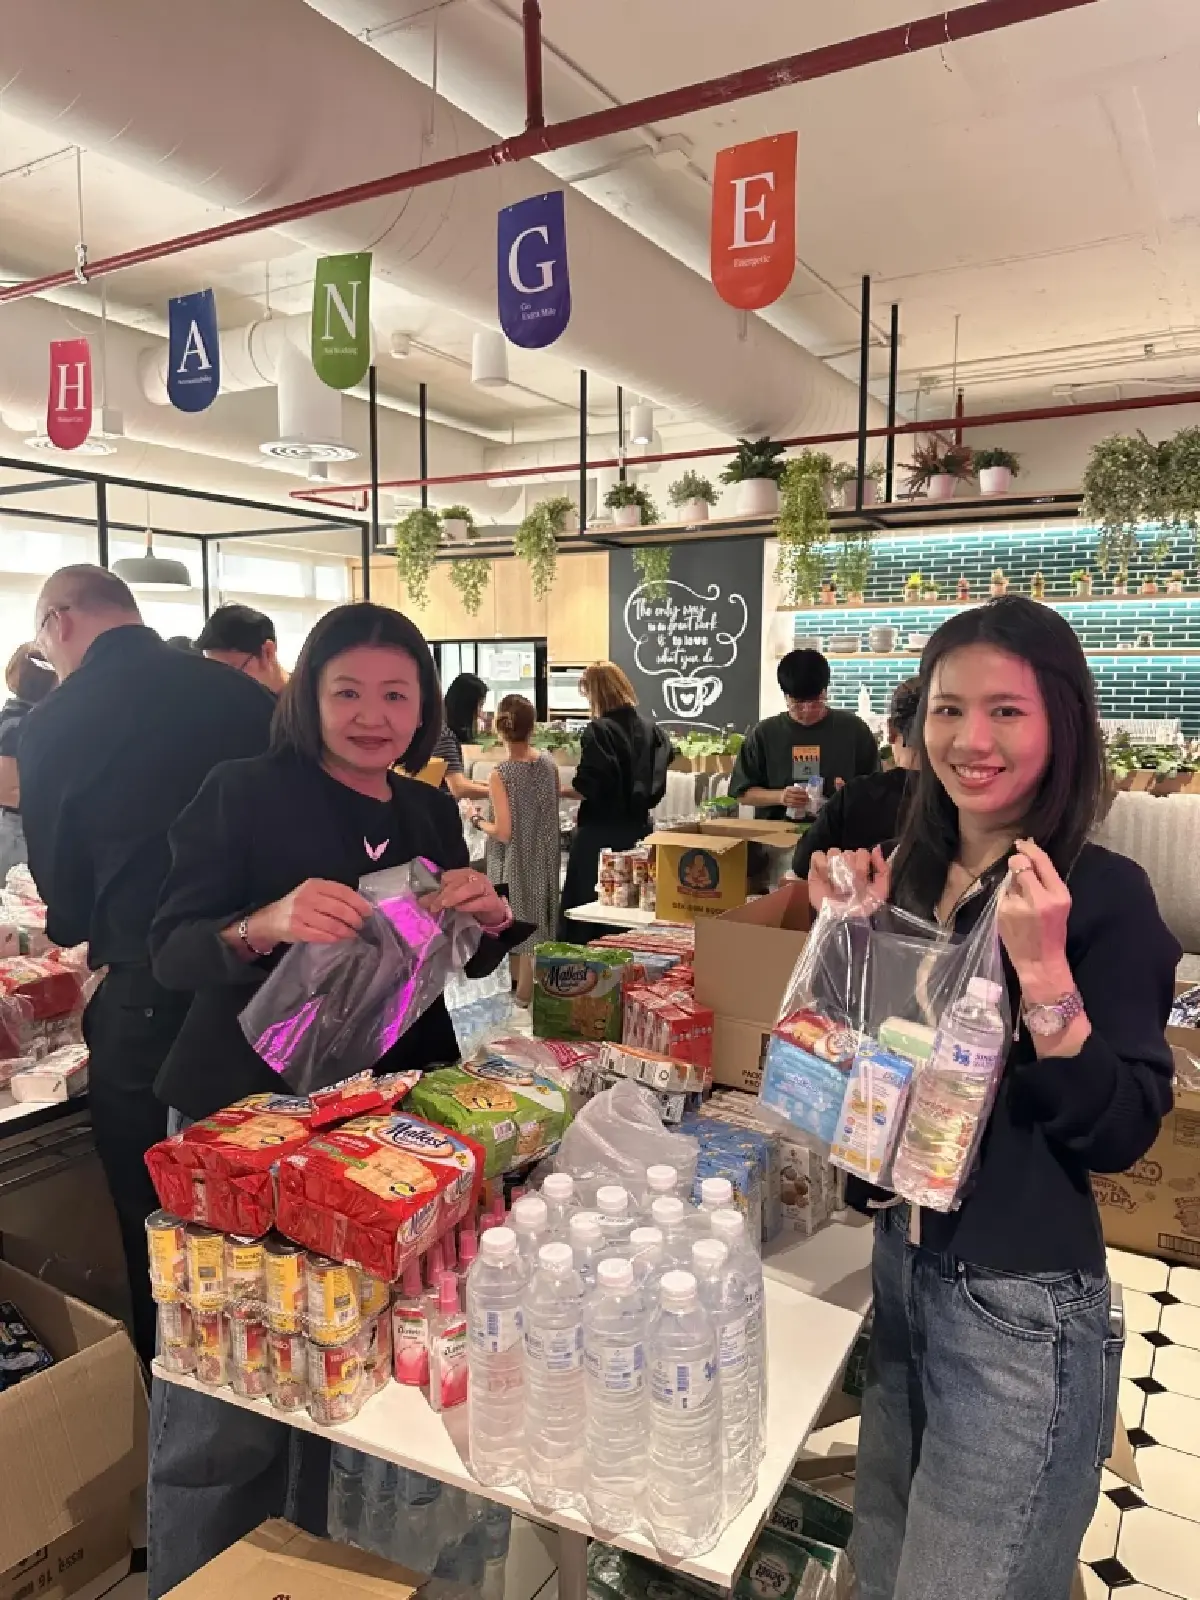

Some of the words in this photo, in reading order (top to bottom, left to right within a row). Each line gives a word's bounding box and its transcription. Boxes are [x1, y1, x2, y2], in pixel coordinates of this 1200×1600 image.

[728, 172, 776, 250] E
[508, 225, 556, 294] G
[321, 281, 362, 340] N
[177, 320, 212, 373] A
[55, 362, 87, 411] H
[633, 597, 652, 620] The
